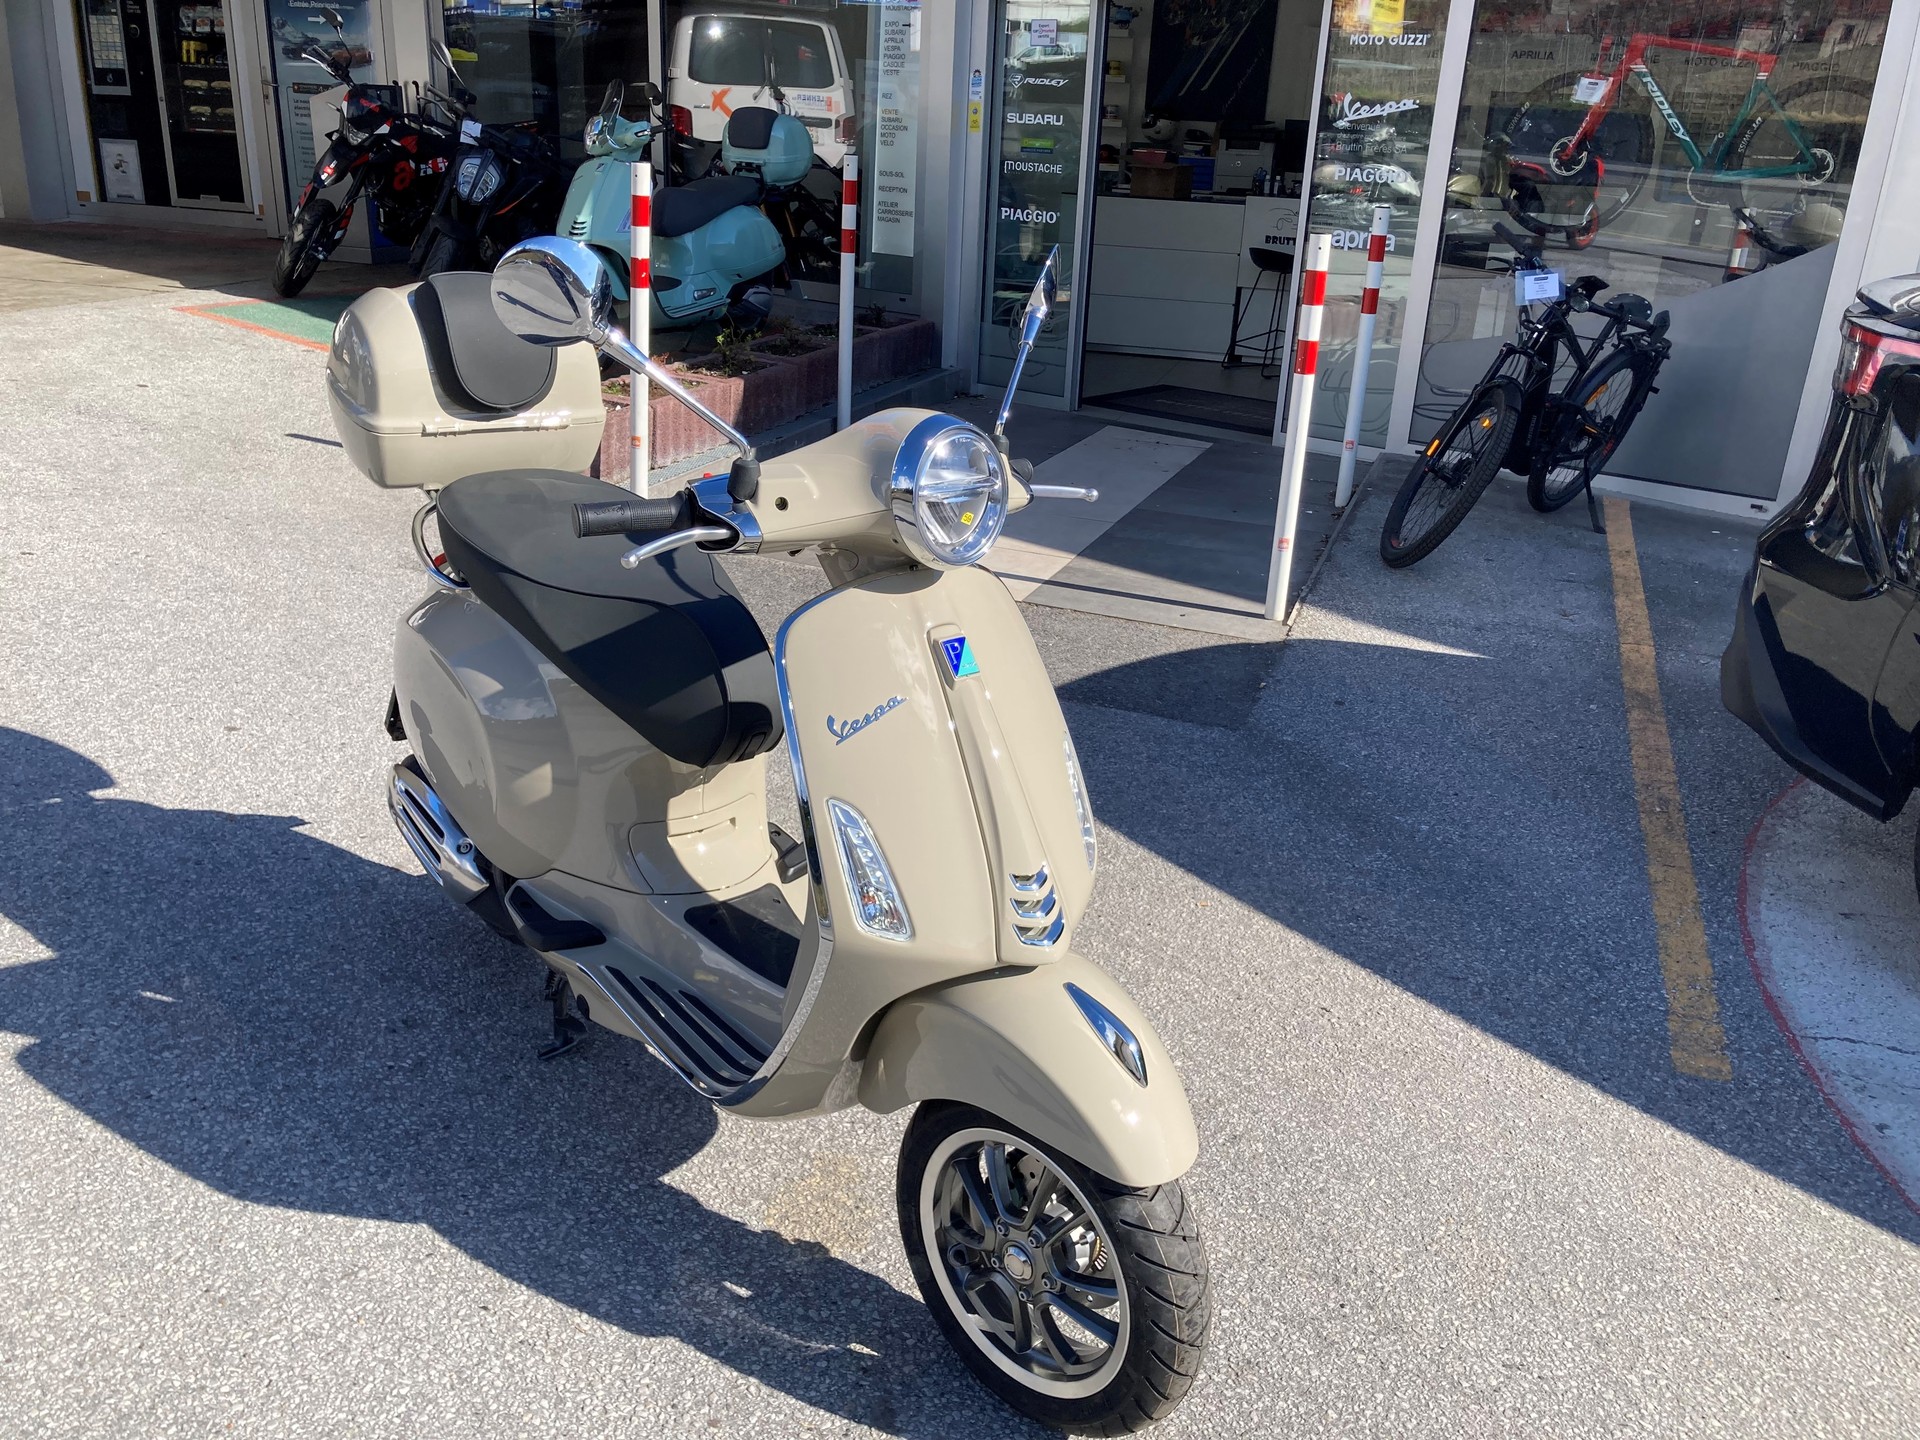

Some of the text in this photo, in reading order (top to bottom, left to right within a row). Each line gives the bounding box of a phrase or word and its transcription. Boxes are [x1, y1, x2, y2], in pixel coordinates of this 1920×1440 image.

[1350, 34, 1427, 46] MOTO GUZZI
[1511, 51, 1554, 61] APRILIA
[1792, 62, 1840, 73] PIAGGIO
[1024, 77, 1069, 88] RIDLEY
[1343, 92, 1419, 121] Vespa
[1642, 77, 1693, 144] RIDLEY
[1007, 113, 1063, 126] SUBARU
[1738, 129, 1754, 154] SWISS
[1336, 142, 1363, 152] Bruttin
[1395, 145, 1407, 154] SA
[1004, 160, 1062, 174] MOUSTACHE
[879, 170, 904, 178] SOUS-SOL
[879, 185, 908, 193] RECEPTION
[878, 208, 914, 217] CARROSSERIE
[1001, 207, 1057, 224] PIAGGIO
[1332, 229, 1396, 251] apria
[827, 695, 908, 745] Vespa
